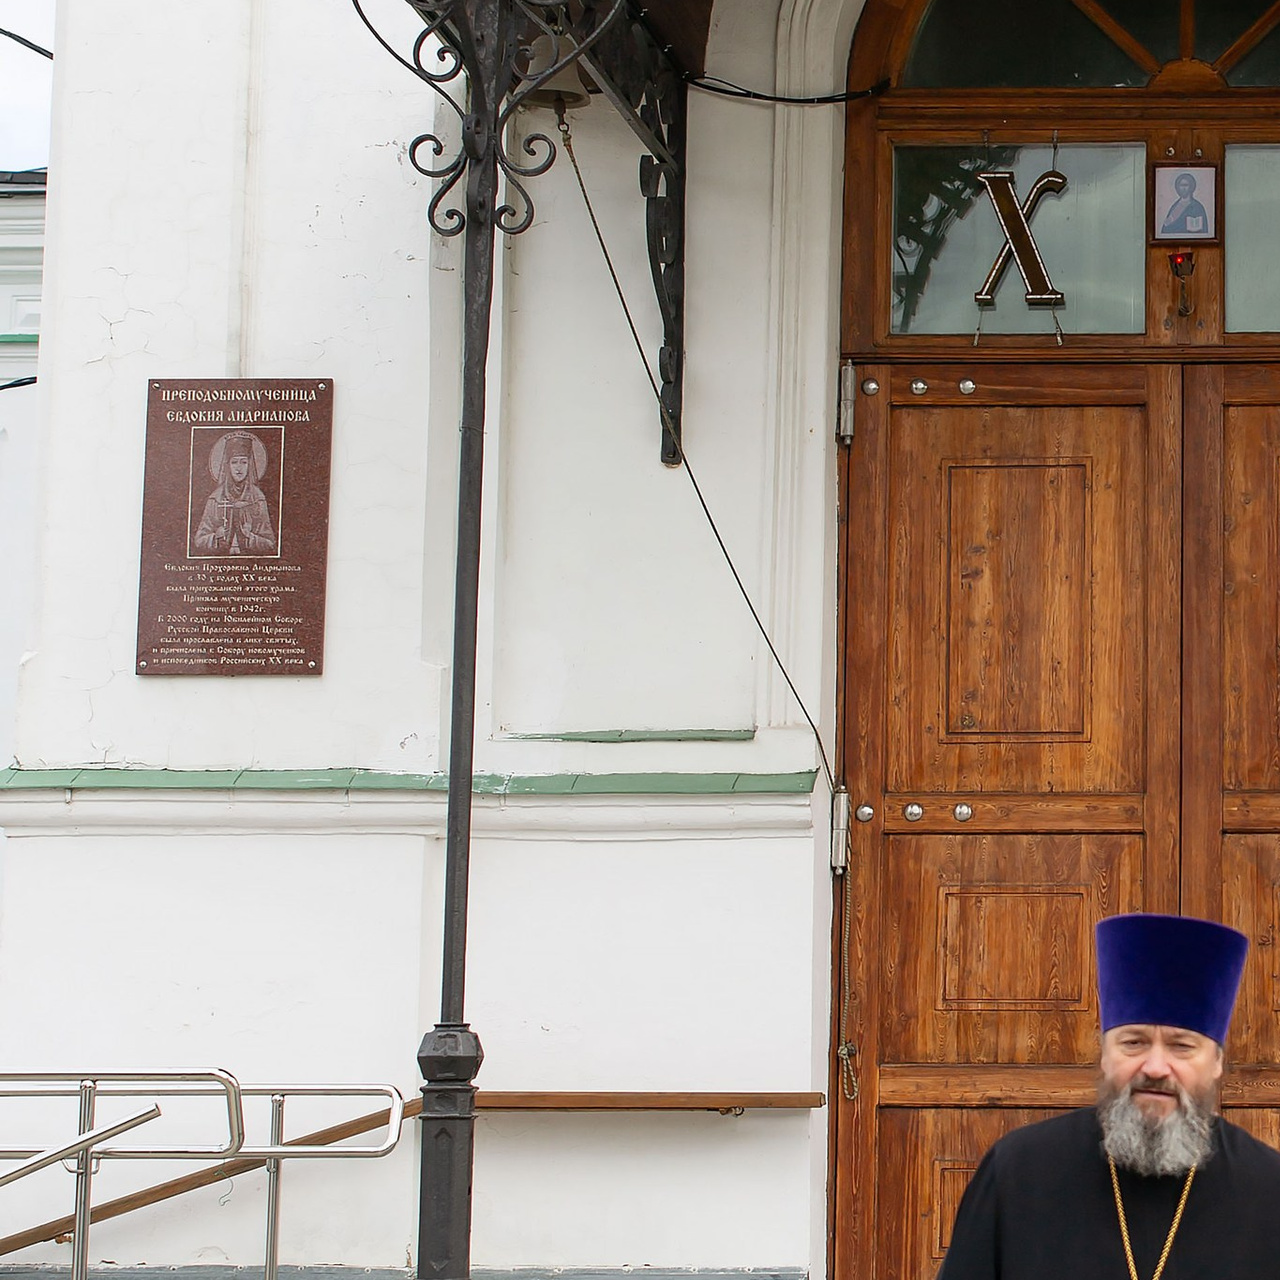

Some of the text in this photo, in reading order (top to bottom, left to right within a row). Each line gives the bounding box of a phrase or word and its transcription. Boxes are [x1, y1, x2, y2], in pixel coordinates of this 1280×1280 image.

[162, 389, 317, 403] ПРЕПОДОБНОМУЧЕНИЦА
[167, 411, 310, 422] ЕВДОКИЯ АНДРИАНОВА
[203, 563, 249, 572] Прохоровна
[252, 563, 301, 572] Андрианова
